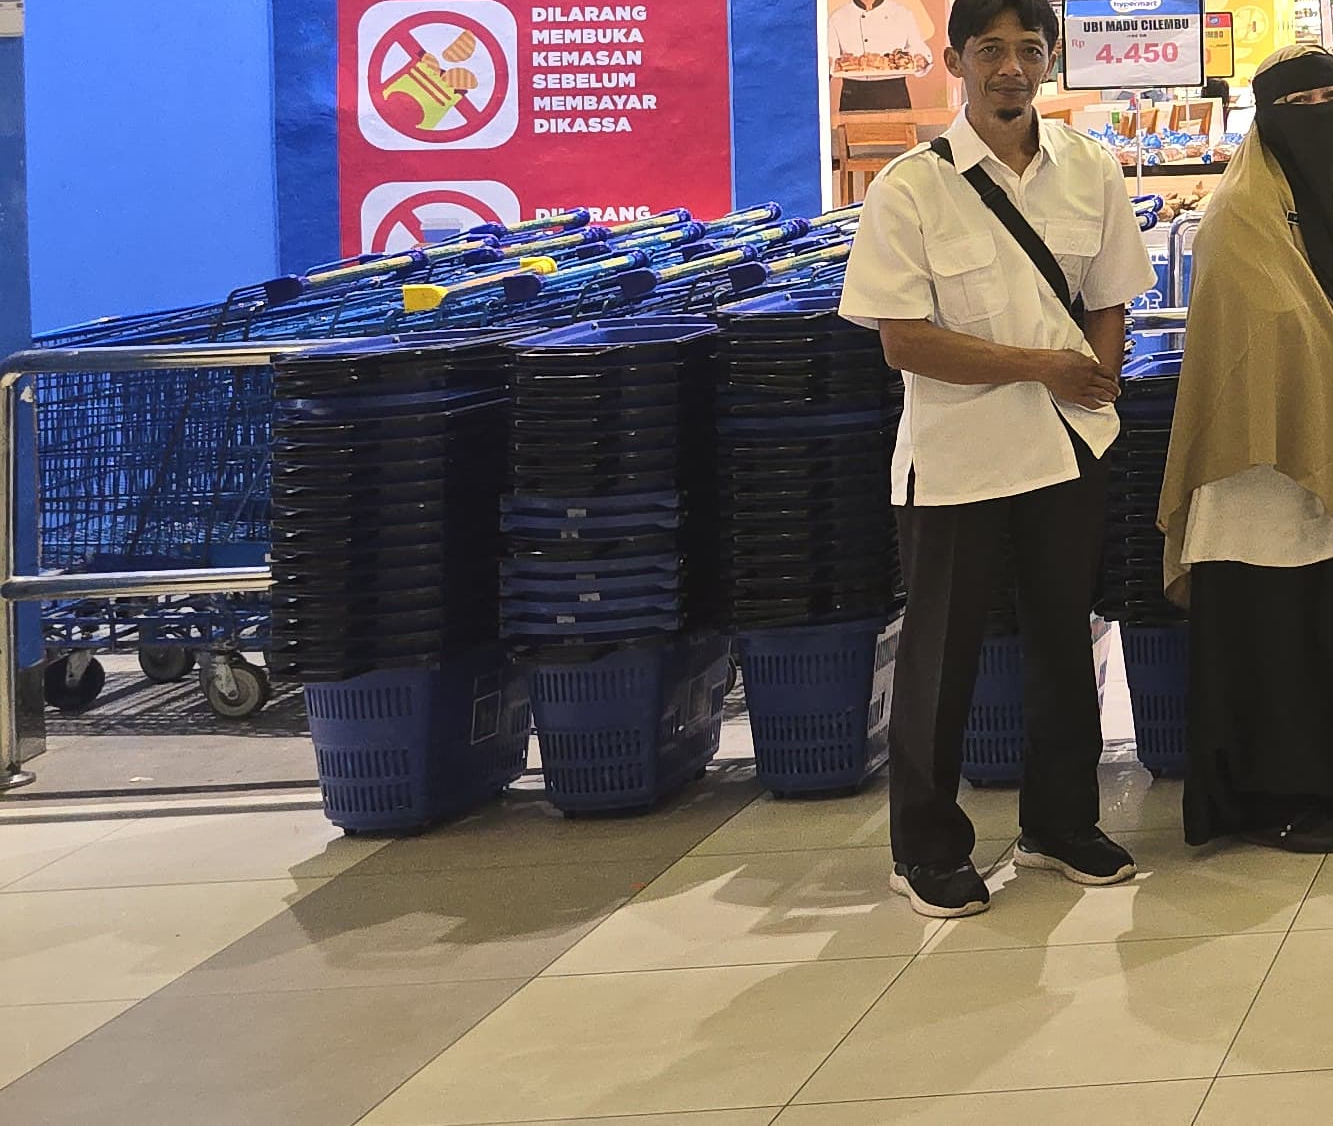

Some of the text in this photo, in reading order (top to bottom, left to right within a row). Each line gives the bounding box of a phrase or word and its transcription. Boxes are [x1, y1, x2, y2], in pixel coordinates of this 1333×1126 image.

[1113, 0, 1158, 9] hypermart
[531, 5, 647, 23] DILARANG
[1083, 18, 1189, 33] UBI MADU CILEMBU
[531, 28, 645, 45] MEMBUKA
[531, 50, 643, 67] KEMASAN
[1071, 38, 1179, 64] Rp 4.450
[532, 72, 636, 89] SEBELUM
[532, 94, 658, 112] MEMBAYAR
[533, 116, 632, 134] DIKASSA
[535, 207, 651, 223] DIRANG
